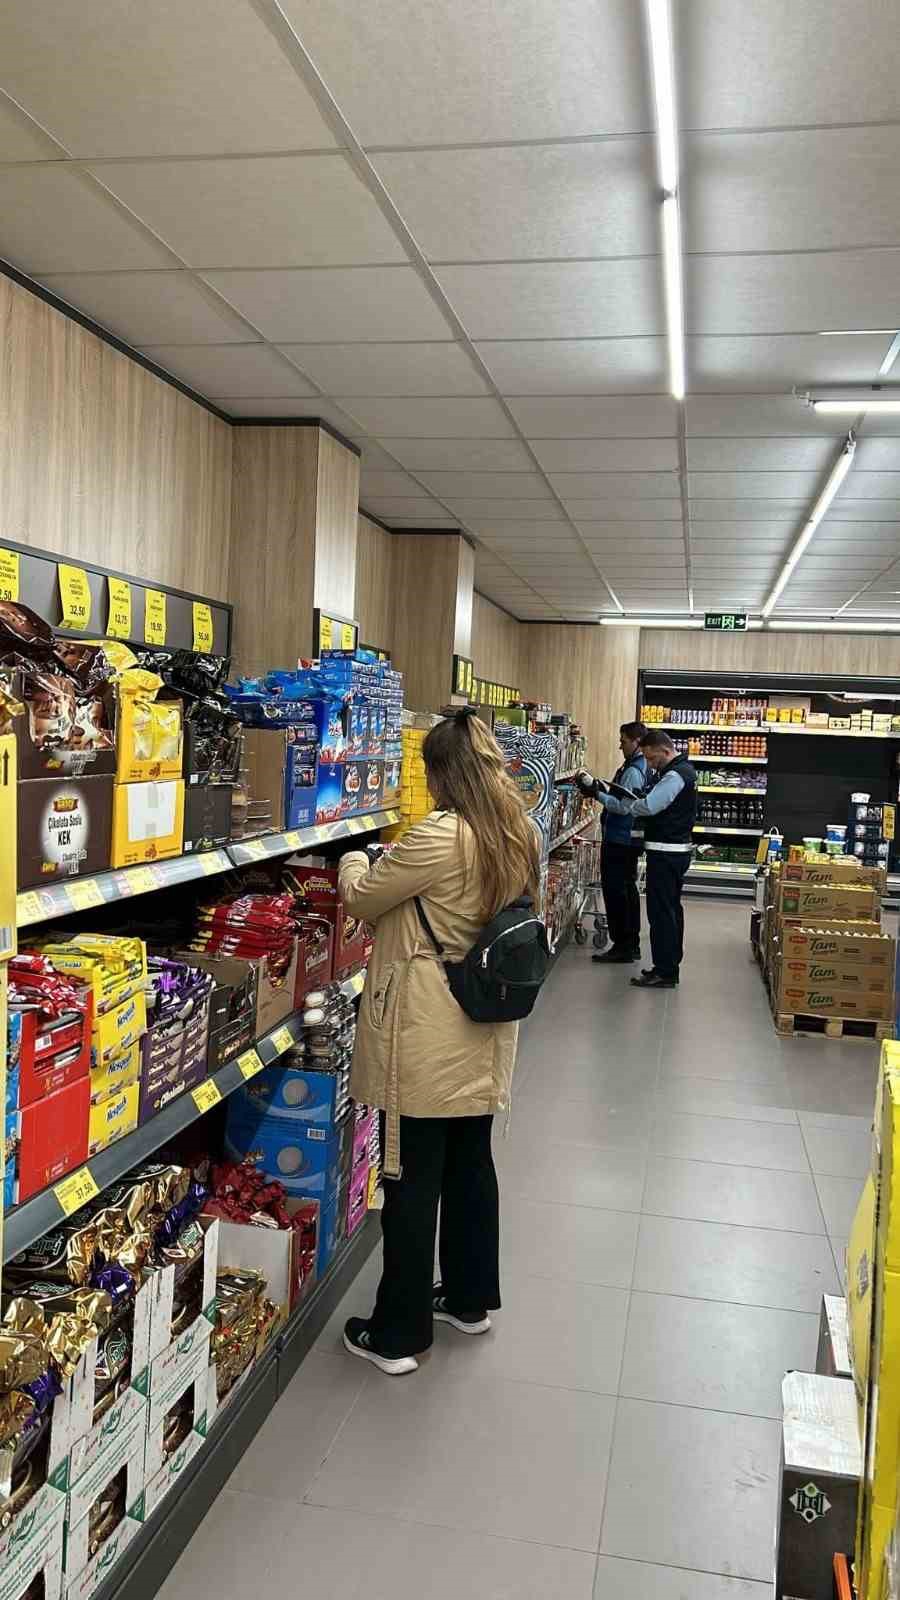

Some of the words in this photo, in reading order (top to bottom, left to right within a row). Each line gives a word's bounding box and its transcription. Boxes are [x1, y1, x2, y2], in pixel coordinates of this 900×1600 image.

[707, 617, 720, 625] EXIT
[58, 830, 71, 846] KEK
[805, 870, 832, 881] Tam
[76, 1182, 94, 1200] 37,50
